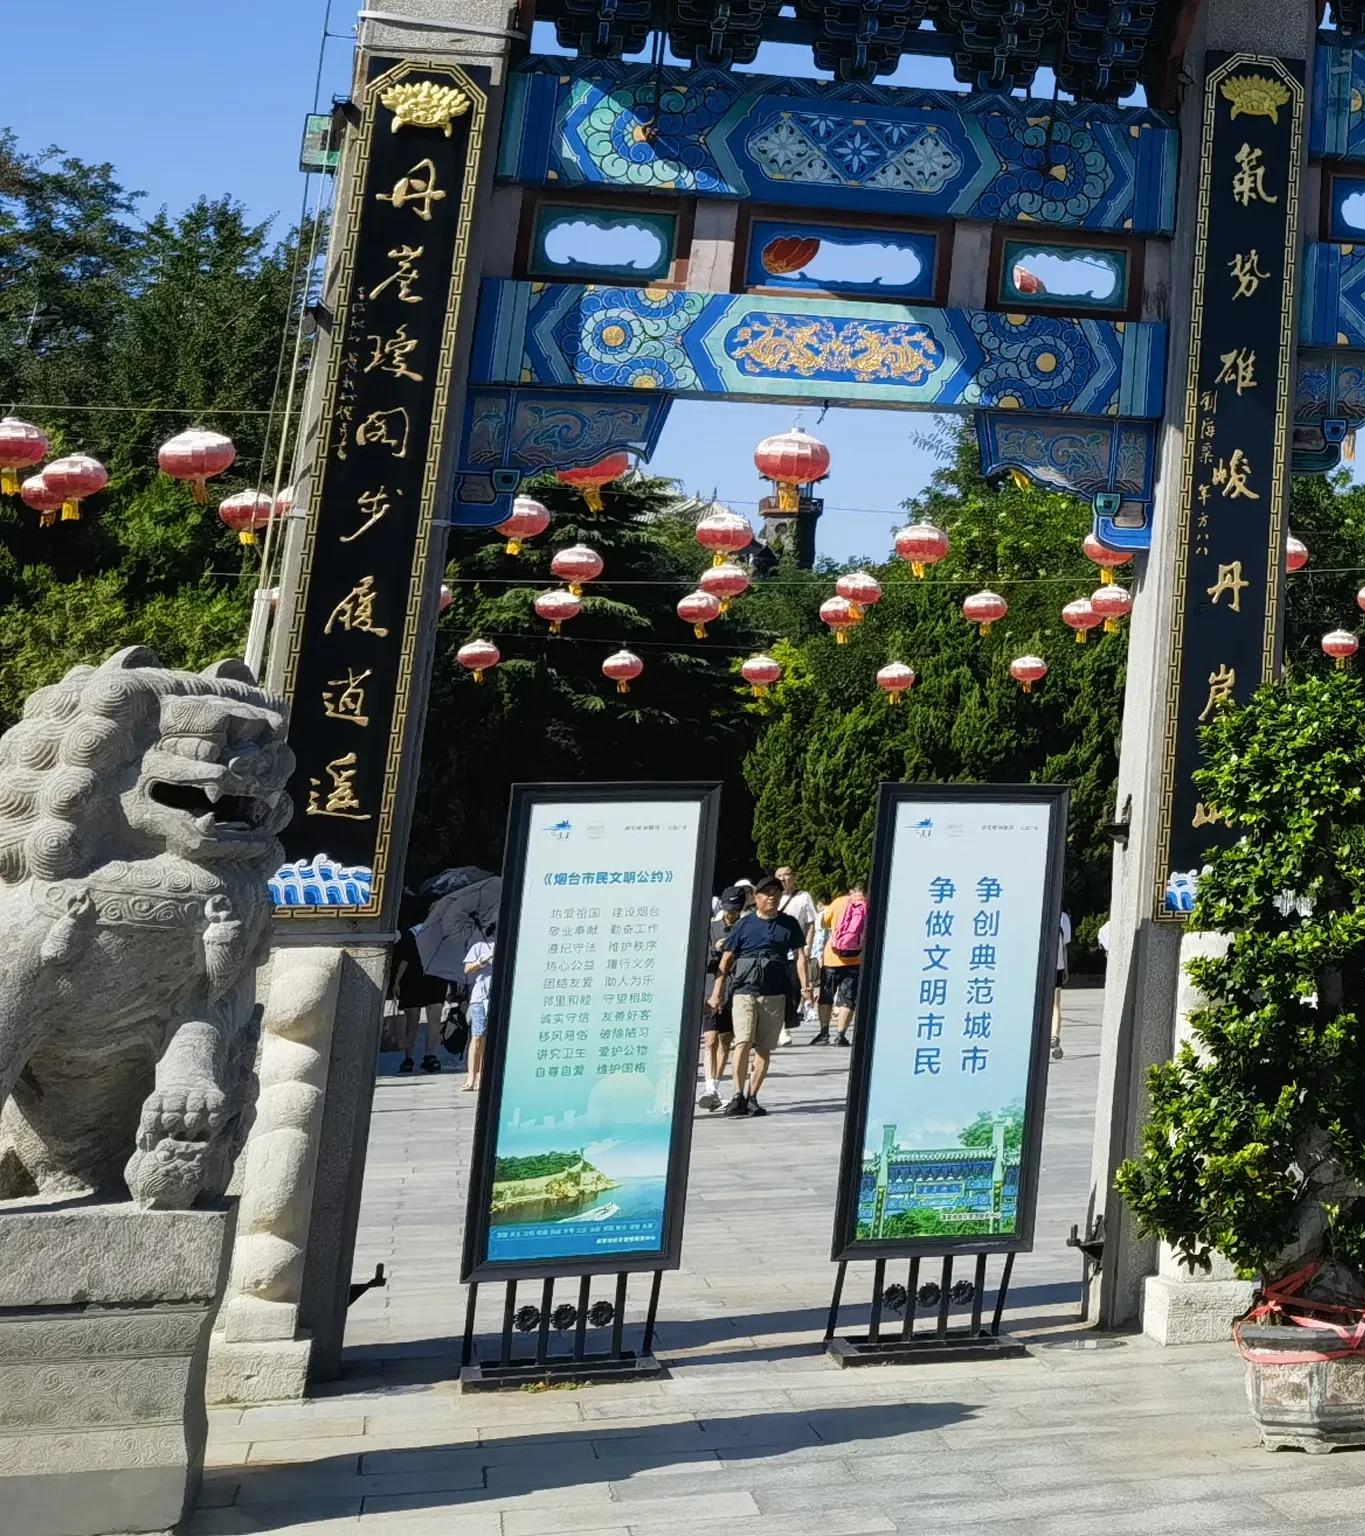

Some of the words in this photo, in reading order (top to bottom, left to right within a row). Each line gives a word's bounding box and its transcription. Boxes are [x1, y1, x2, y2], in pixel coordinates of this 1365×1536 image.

[544, 870, 673, 886] 《烟台市民文明公约》
[914, 875, 957, 1076] 争做文明市民
[960, 875, 1004, 1075] 争创典范城市
